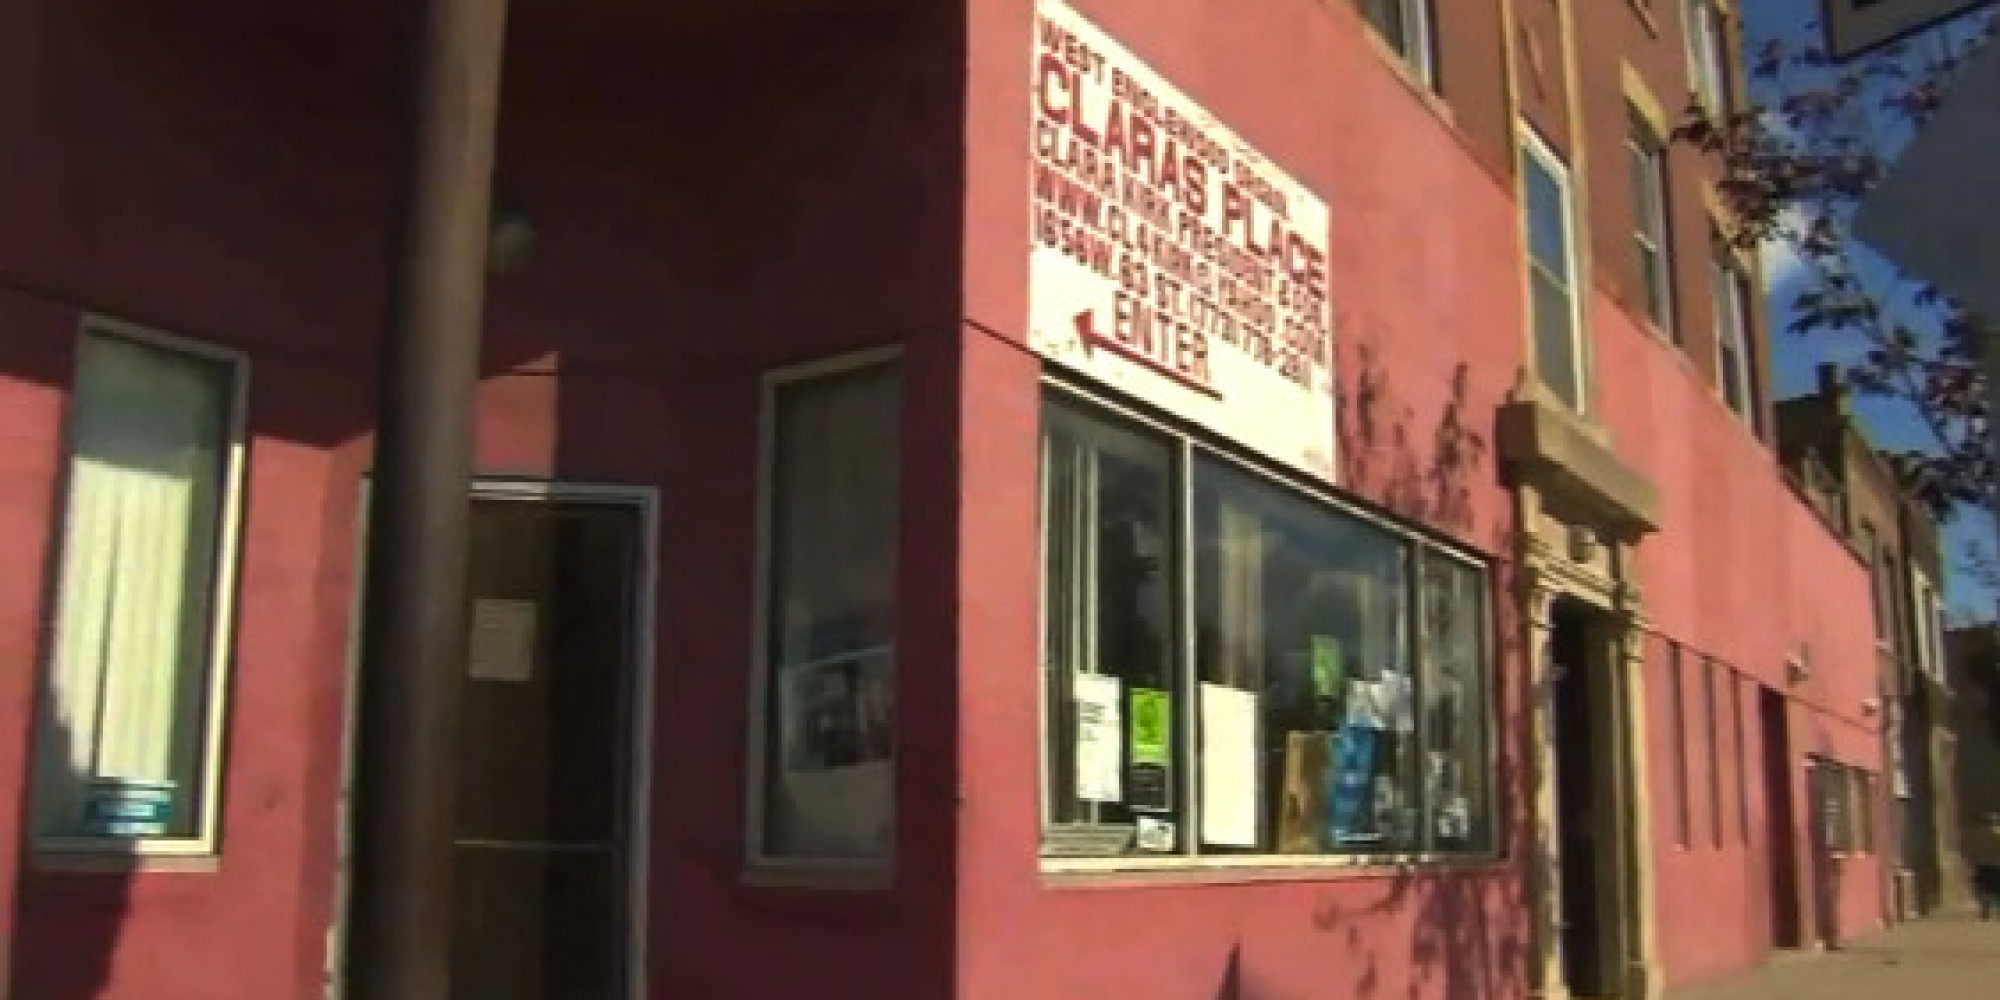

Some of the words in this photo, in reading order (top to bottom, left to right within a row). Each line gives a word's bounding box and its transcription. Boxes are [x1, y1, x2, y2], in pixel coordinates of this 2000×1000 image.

[1040, 20, 1105, 83] WEST
[1037, 119, 1114, 190] CLARA
[1040, 53, 1206, 214] CLARAS
[1222, 180, 1326, 299] PLACE
[1113, 289, 1210, 383] ENTER
